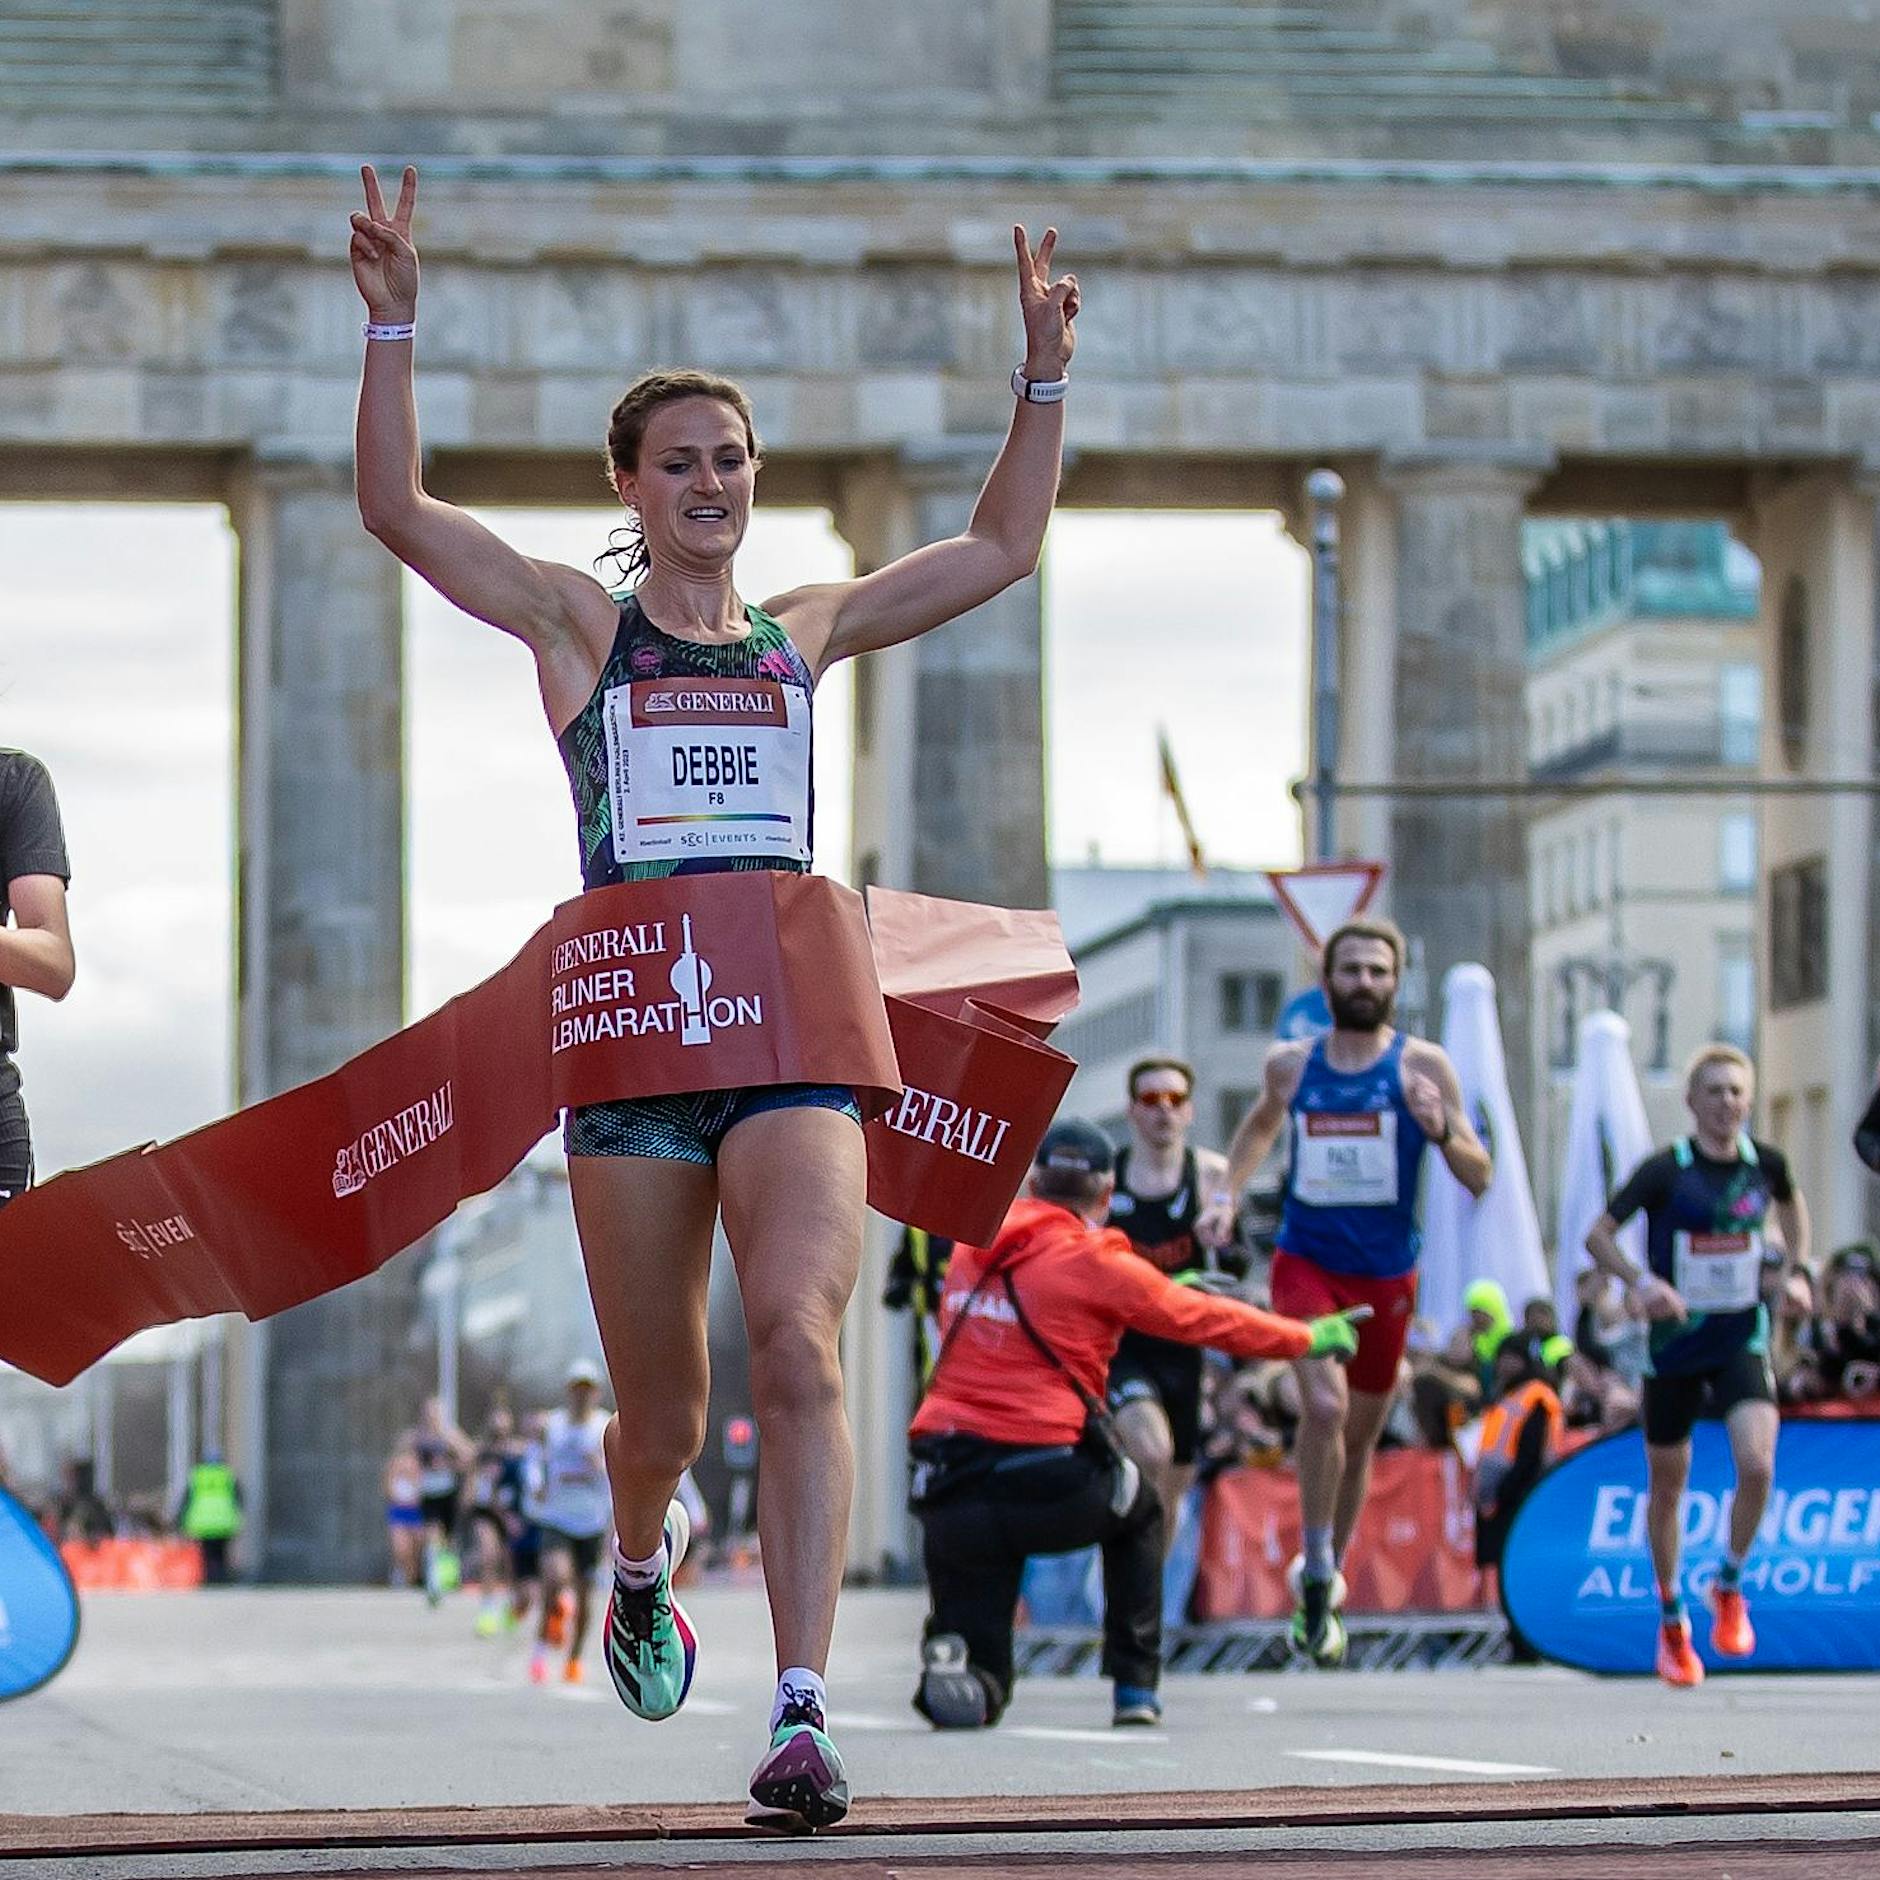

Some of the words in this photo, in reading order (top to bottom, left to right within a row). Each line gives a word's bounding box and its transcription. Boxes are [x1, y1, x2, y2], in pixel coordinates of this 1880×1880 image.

[676, 691, 774, 713] GENERALI
[671, 745, 759, 786] DEBBIE
[708, 792, 725, 805] F8
[554, 922, 666, 975] GENERALI
[361, 1080, 454, 1178] GENERALI
[884, 1084, 1011, 1166] ERALI
